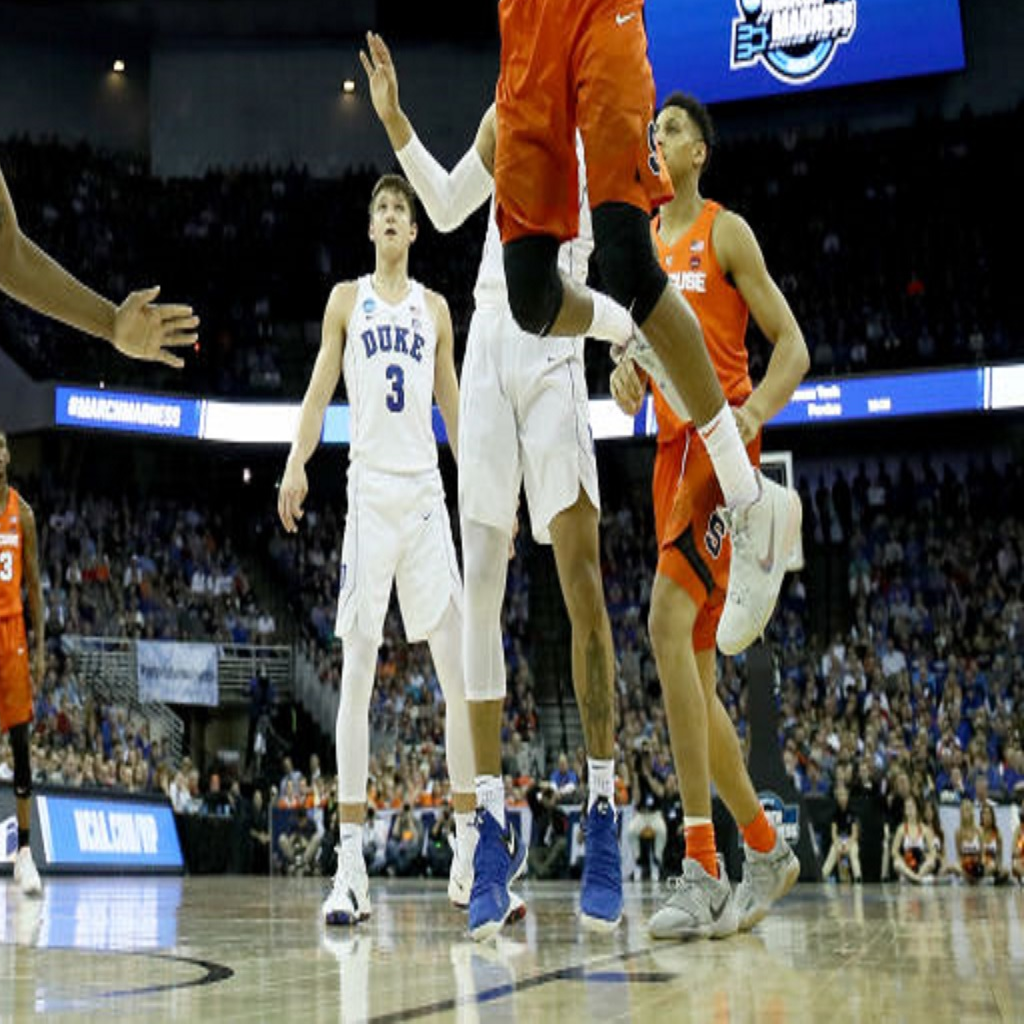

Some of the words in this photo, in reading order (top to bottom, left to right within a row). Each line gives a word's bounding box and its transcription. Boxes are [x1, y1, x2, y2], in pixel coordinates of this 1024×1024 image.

[771, 0, 856, 44] MADNESS
[361, 324, 425, 363] DUKE
[385, 364, 405, 414] 3
